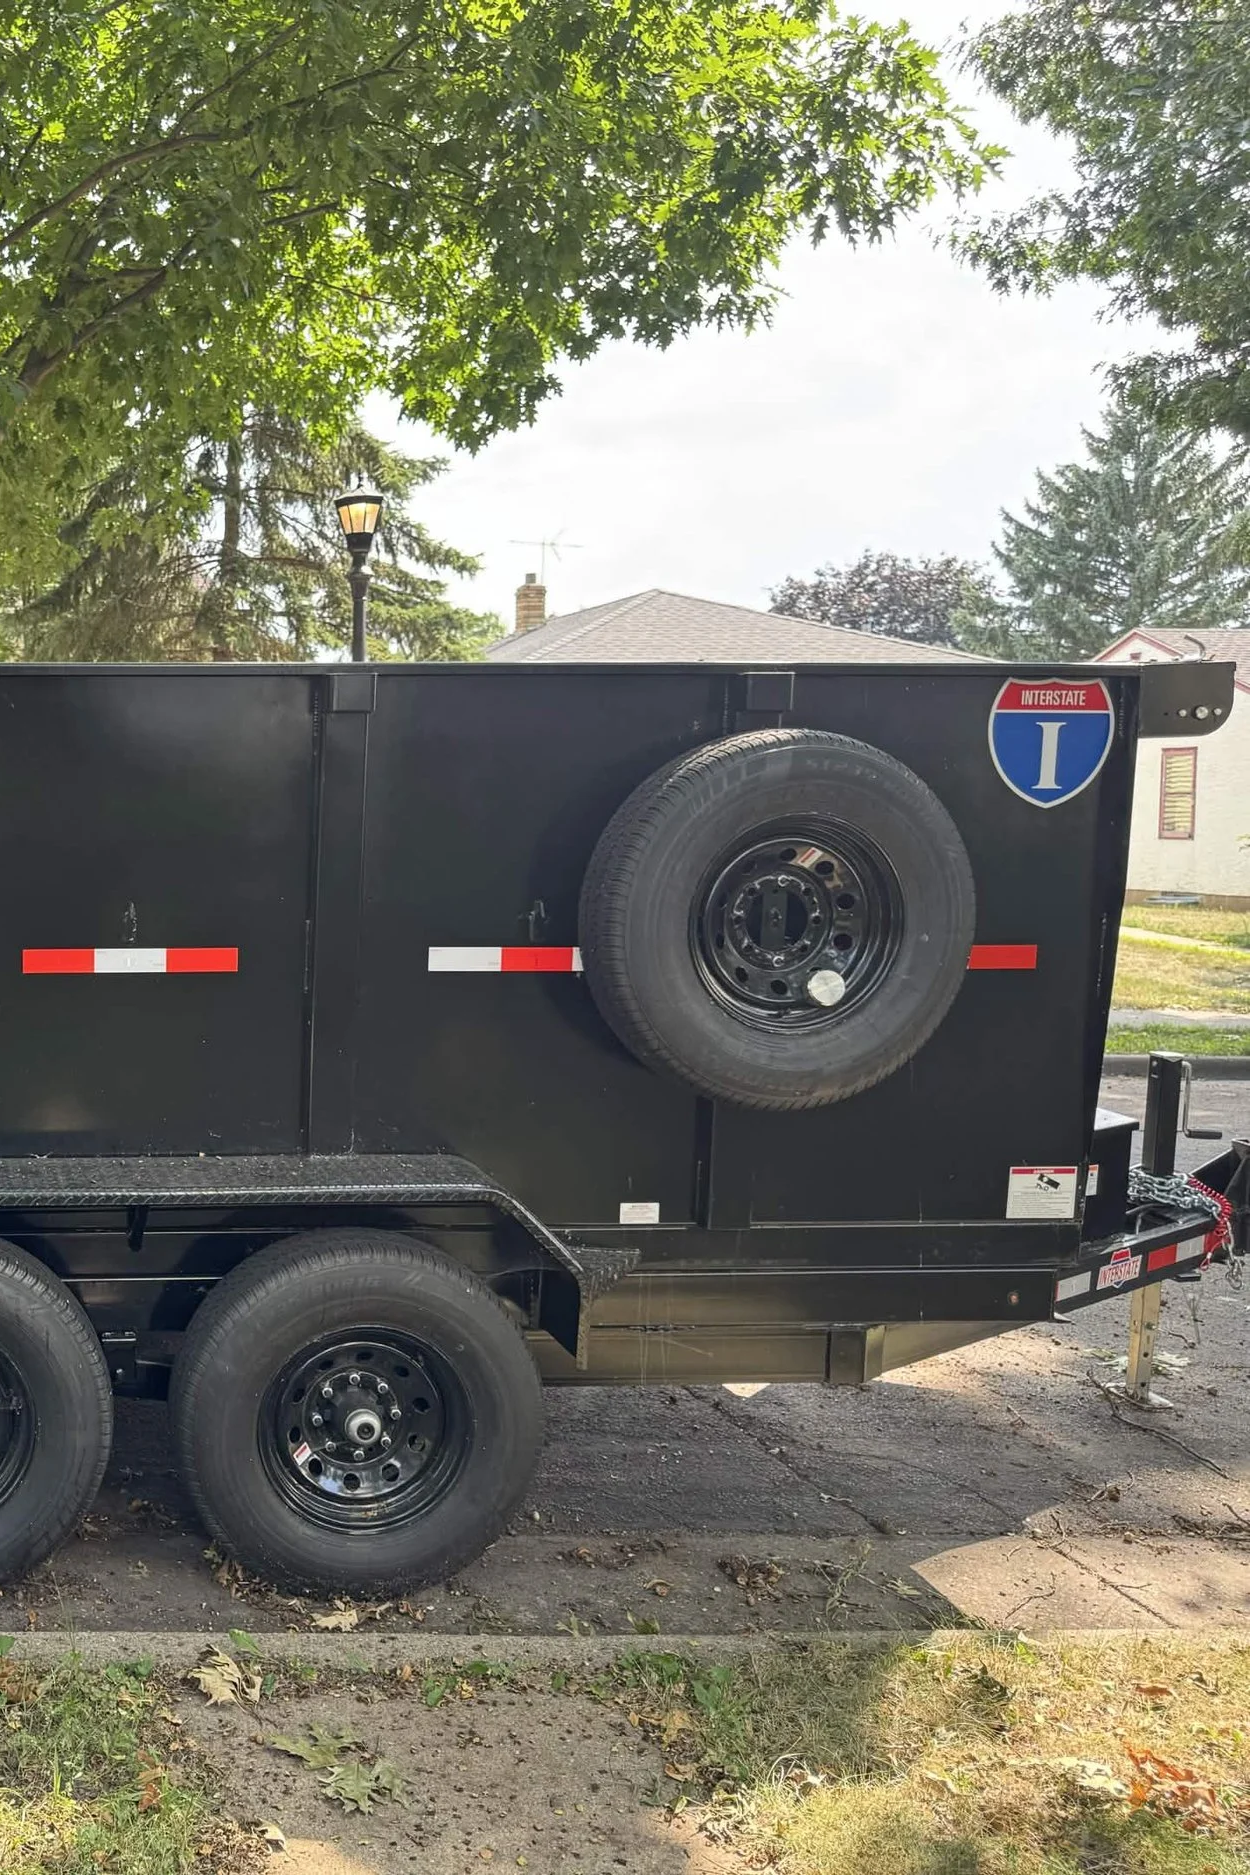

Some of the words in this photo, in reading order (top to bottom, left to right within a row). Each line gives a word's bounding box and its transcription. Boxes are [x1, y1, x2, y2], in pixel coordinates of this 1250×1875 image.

[1021, 690, 1086, 706] INTERSTATE
[1031, 721, 1067, 789] I
[1100, 1259, 1139, 1286] INTERSTATE
